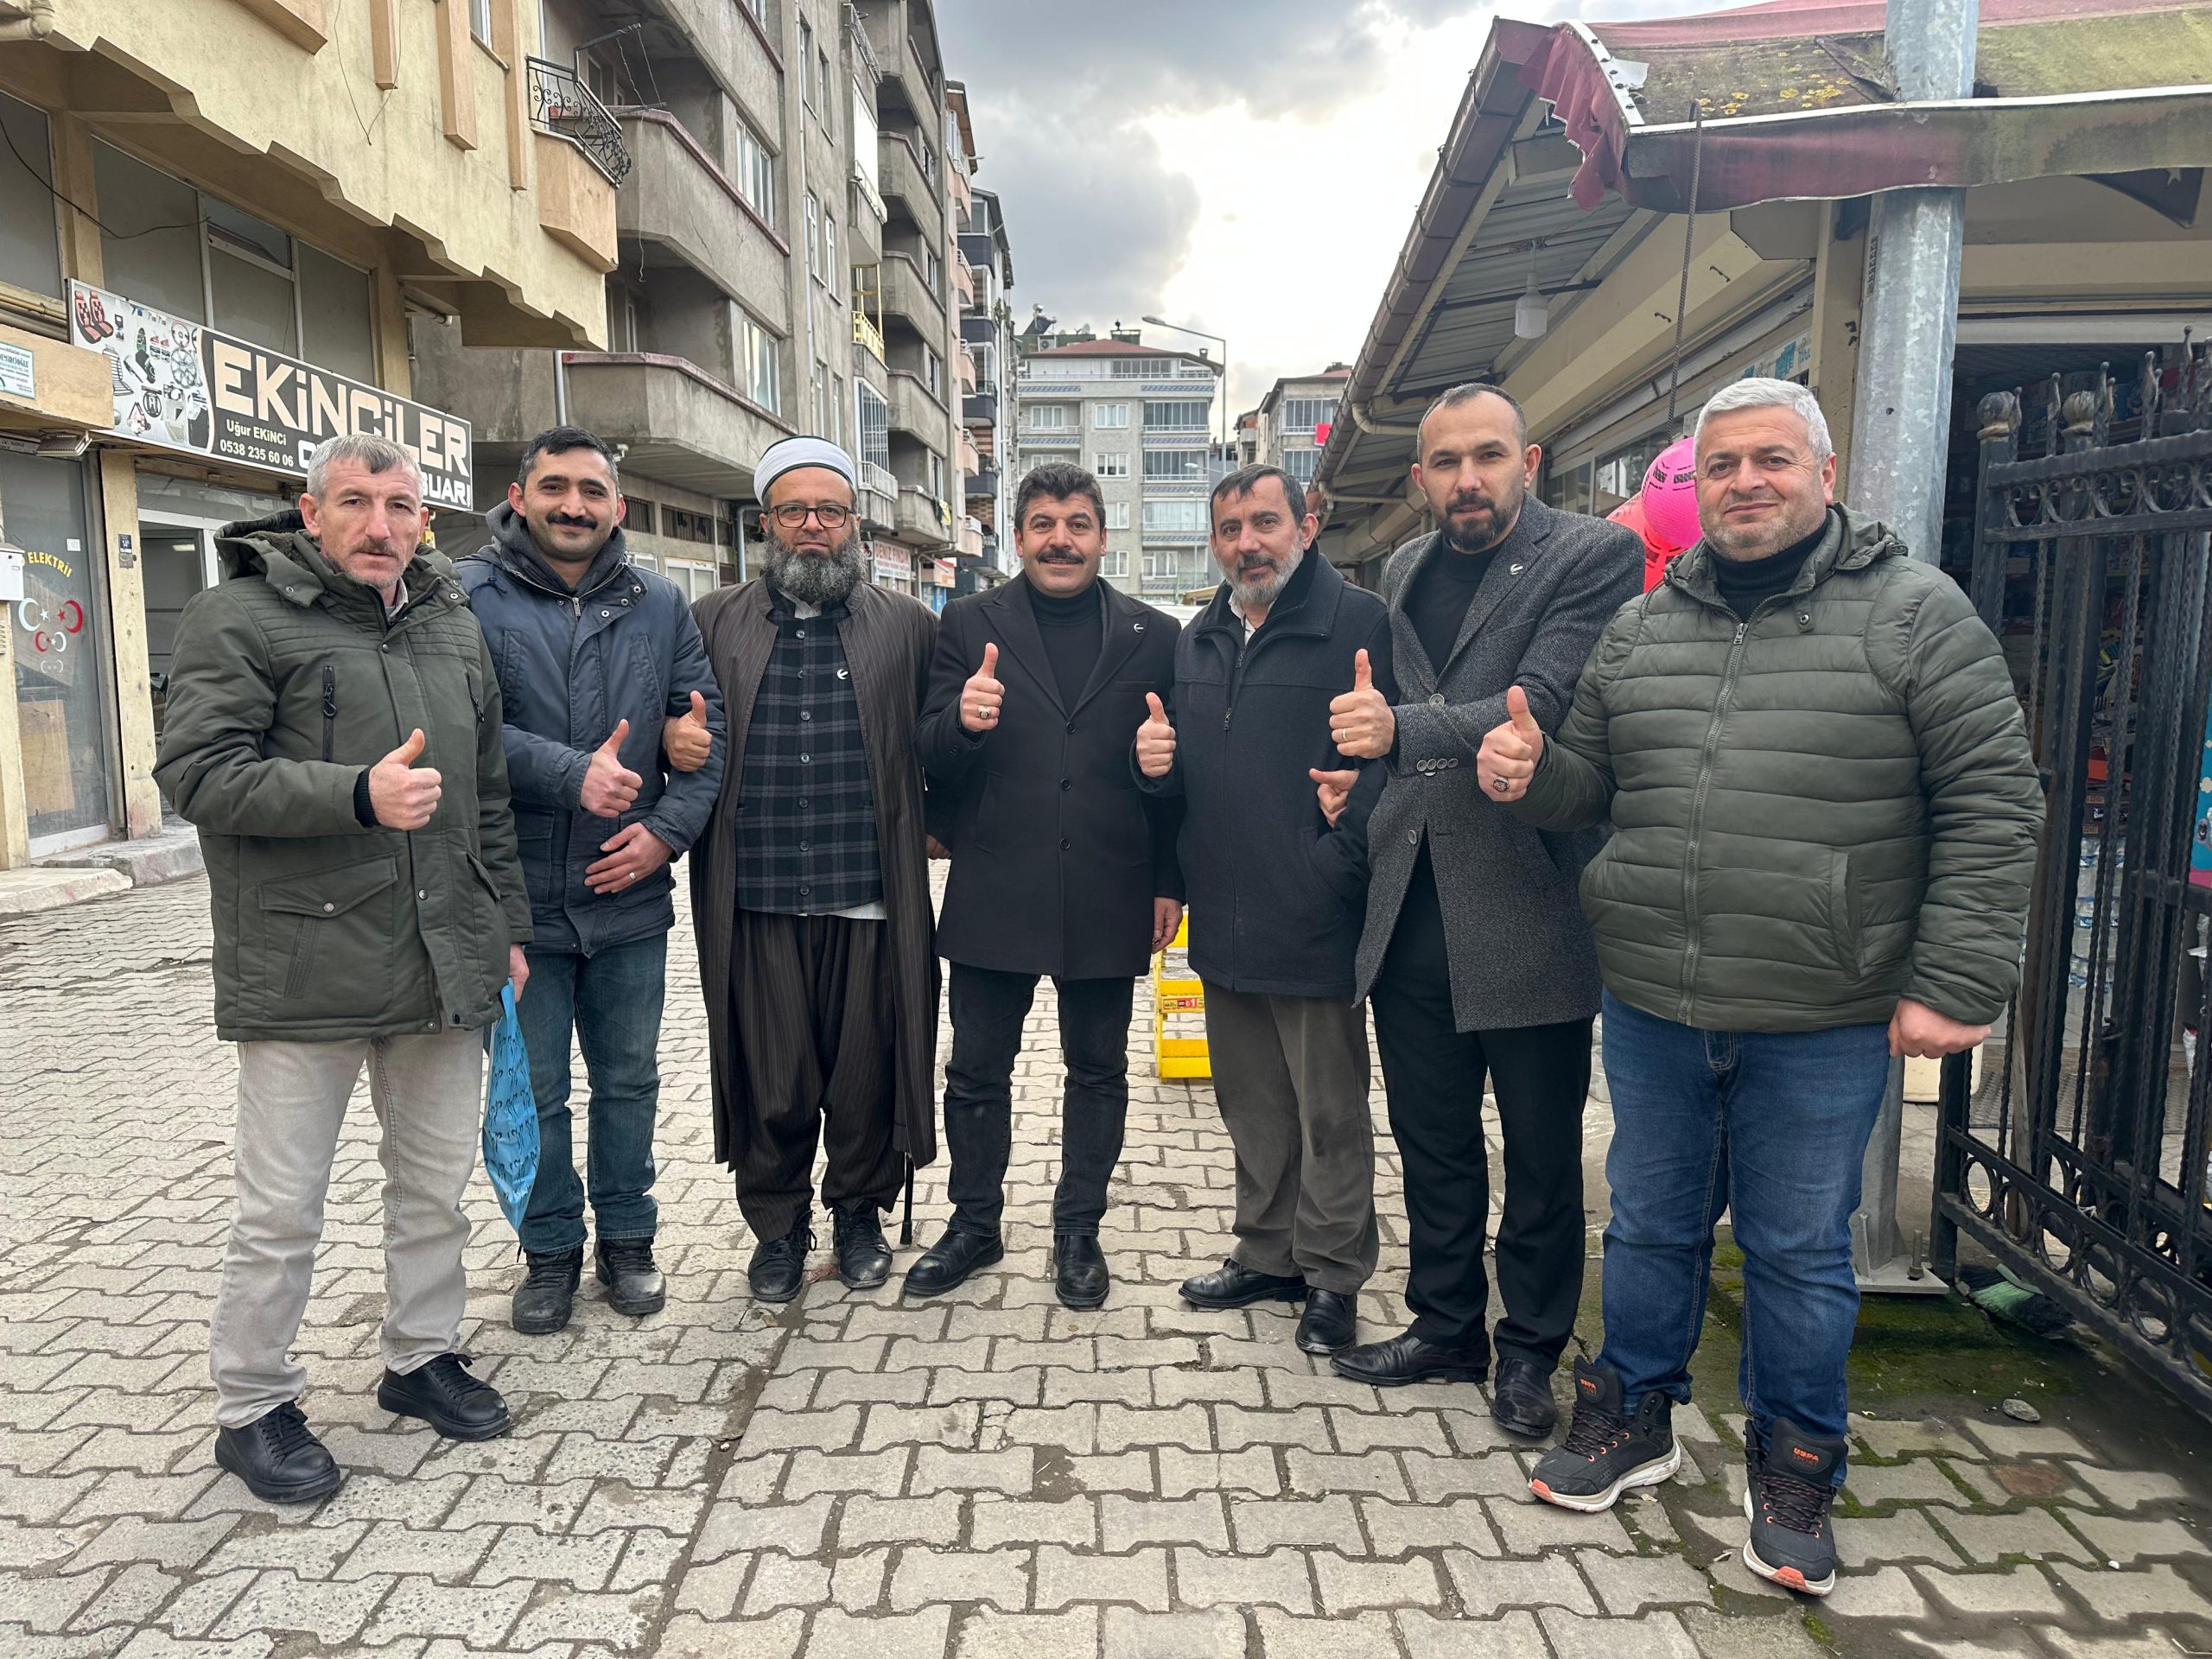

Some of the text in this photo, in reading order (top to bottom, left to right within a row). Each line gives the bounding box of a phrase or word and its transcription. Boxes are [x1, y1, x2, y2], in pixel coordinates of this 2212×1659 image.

[226, 419, 251, 436] Uğur
[219, 439, 294, 467] 0538 235 60 06
